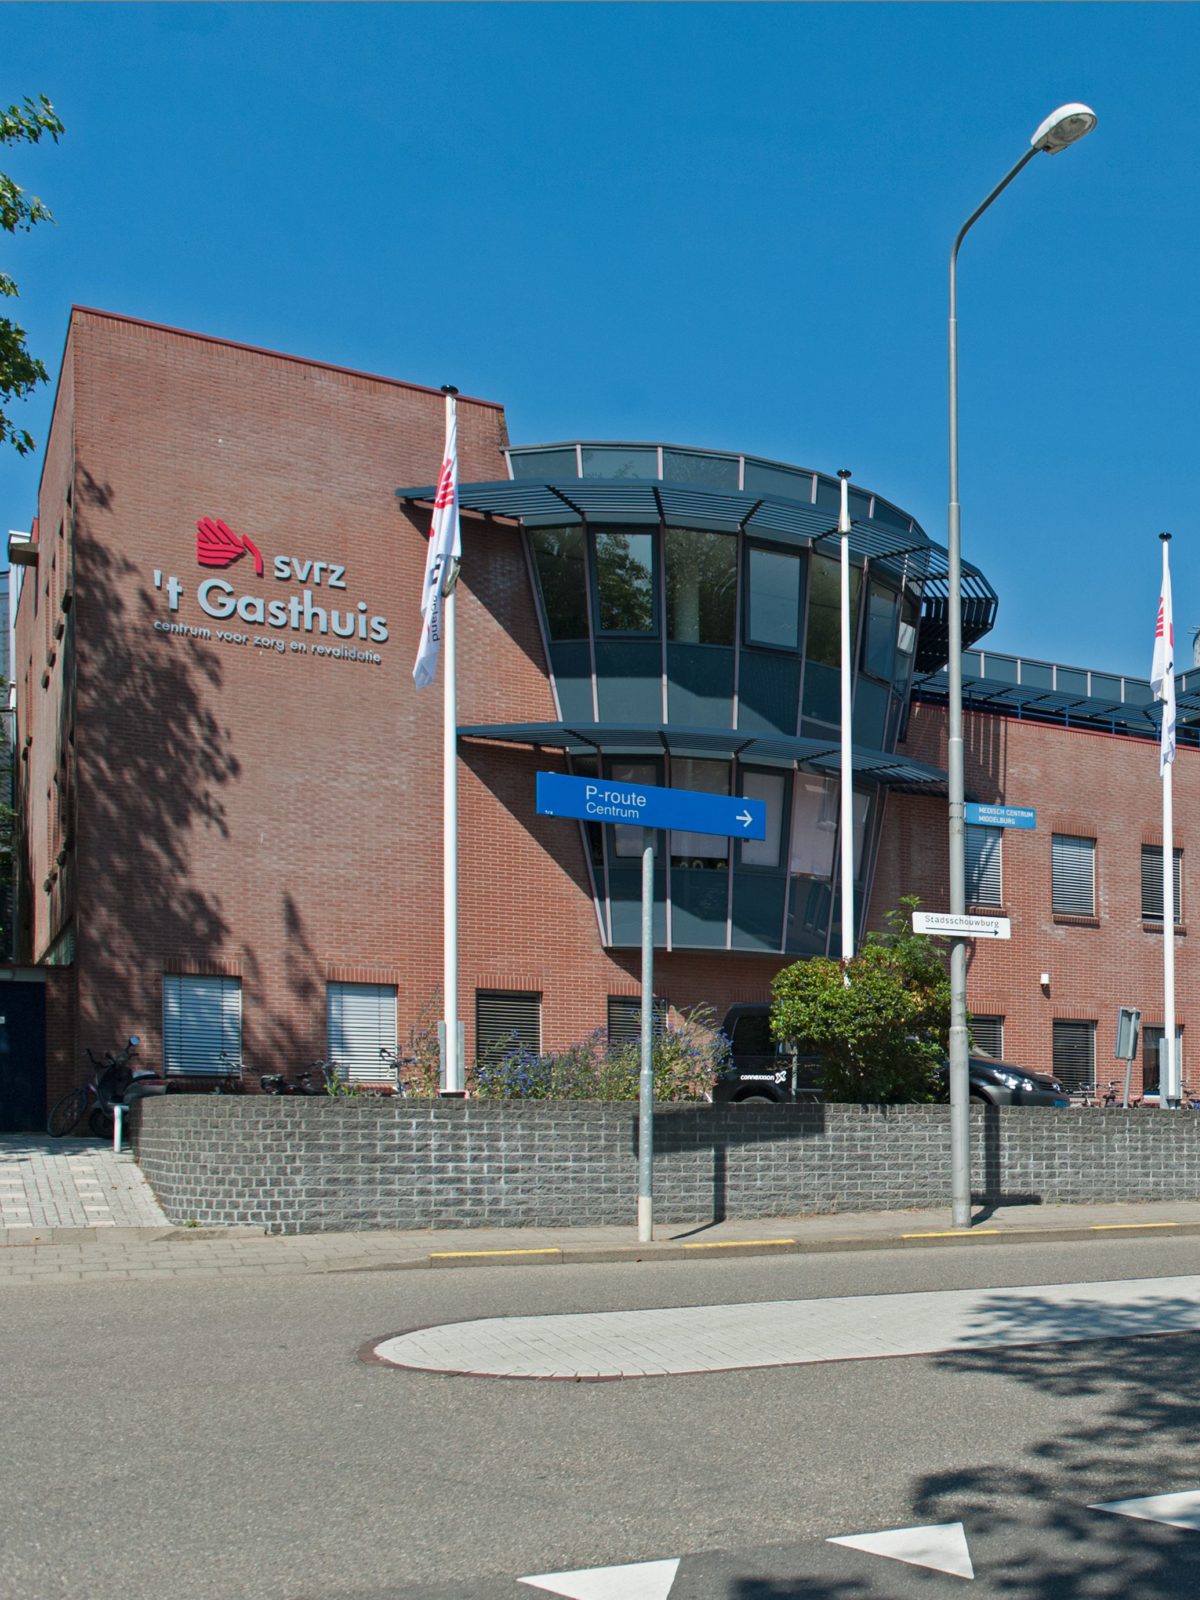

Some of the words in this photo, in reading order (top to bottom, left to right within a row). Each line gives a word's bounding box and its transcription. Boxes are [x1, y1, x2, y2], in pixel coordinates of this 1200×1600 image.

[274, 555, 347, 588] svrz
[153, 569, 183, 610] 't
[197, 578, 389, 643] Gasthuis
[153, 620, 211, 638] centrum
[215, 629, 249, 644] voor
[253, 635, 285, 652] zorg
[289, 640, 307, 652] en
[311, 643, 382, 664] revalidatie
[586, 785, 647, 807] P-route
[586, 802, 639, 819] Centrum
[978, 807, 1005, 815] MEDISCH
[1006, 809, 1033, 818] CENTRUM
[978, 815, 1016, 825] MIDDELBURG
[925, 915, 999, 928] Stadsschouwburg
